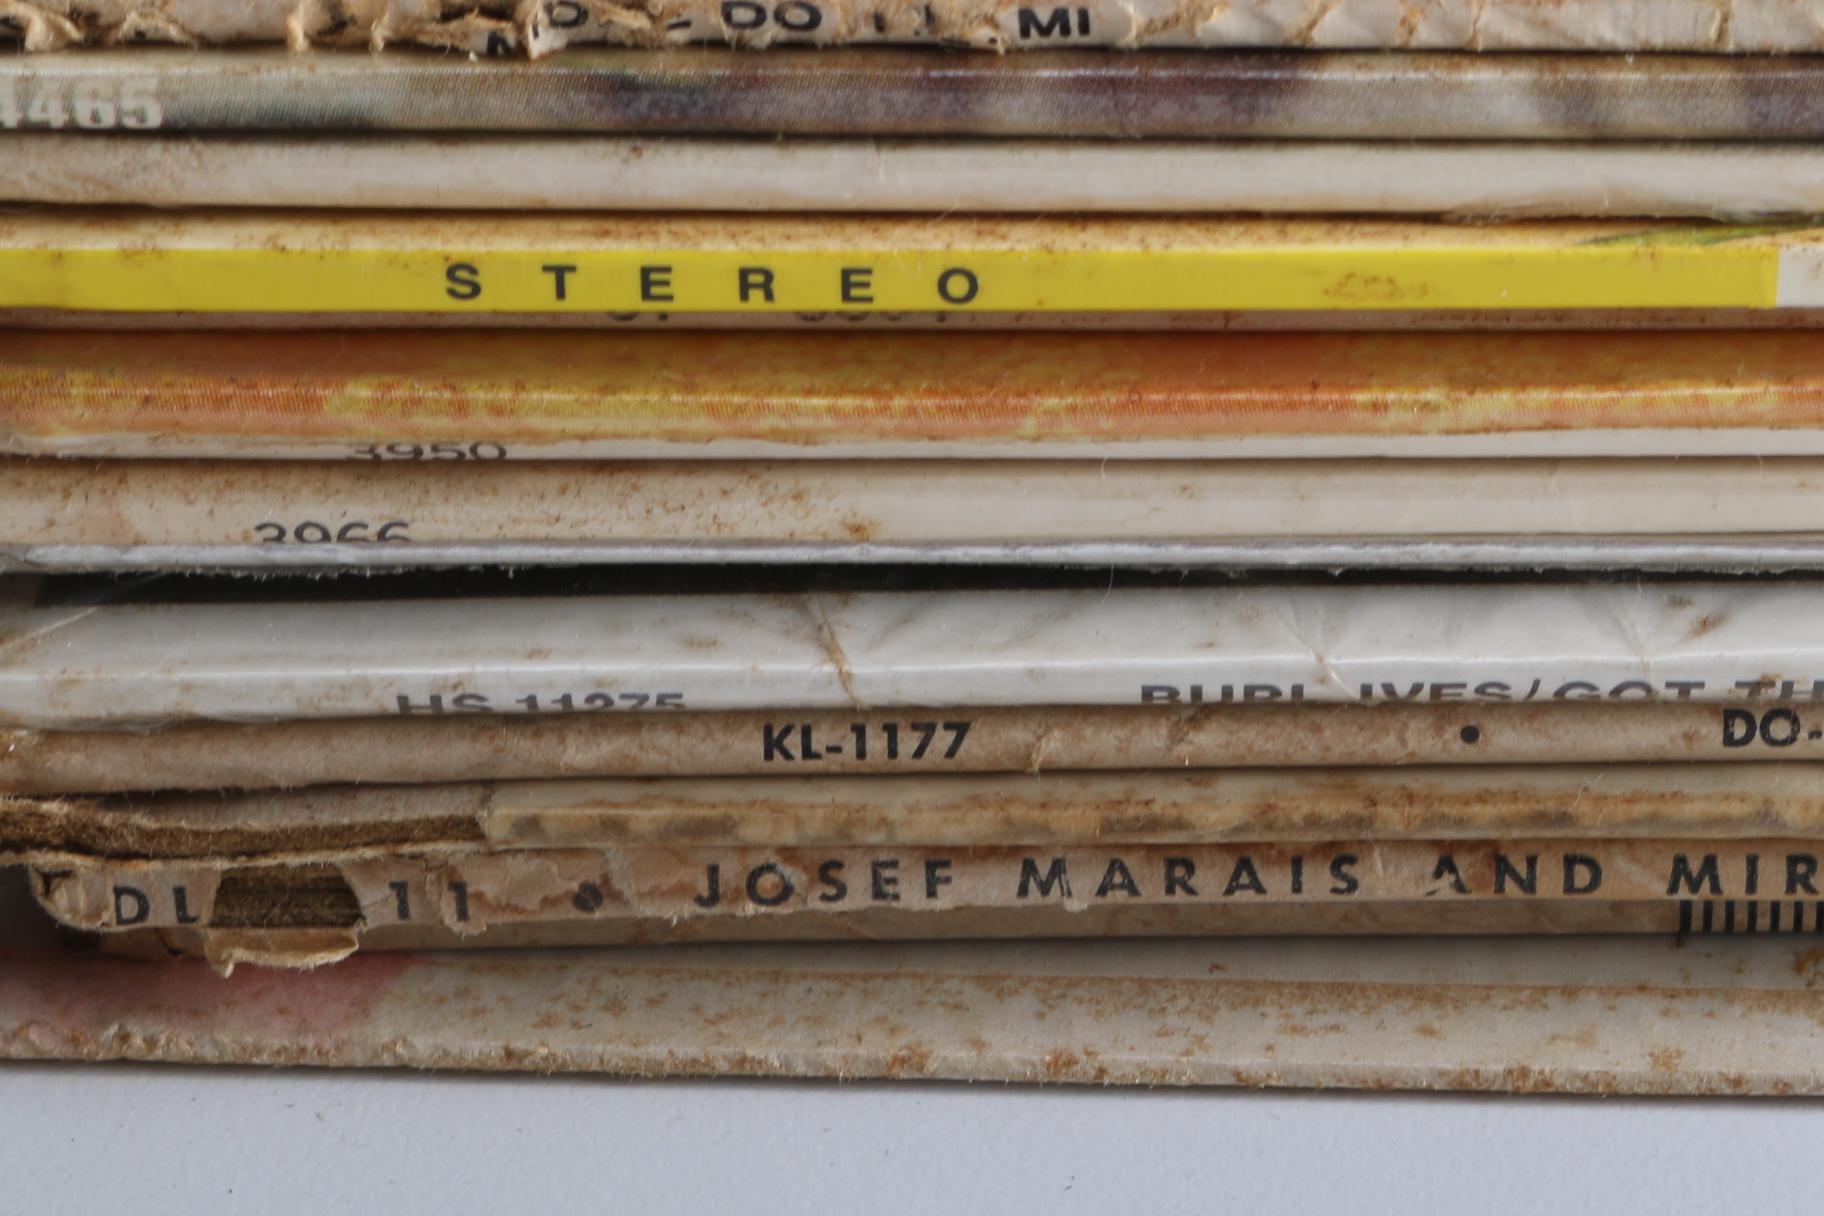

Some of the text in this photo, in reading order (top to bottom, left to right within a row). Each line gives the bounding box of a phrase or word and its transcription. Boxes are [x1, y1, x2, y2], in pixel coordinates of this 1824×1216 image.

[445, 262, 980, 305] STEREO
[762, 723, 972, 762] KL-1177
[694, 858, 953, 909] JOSEF
[1016, 854, 1362, 899] MARAIS
[1424, 853, 1604, 897] AND
